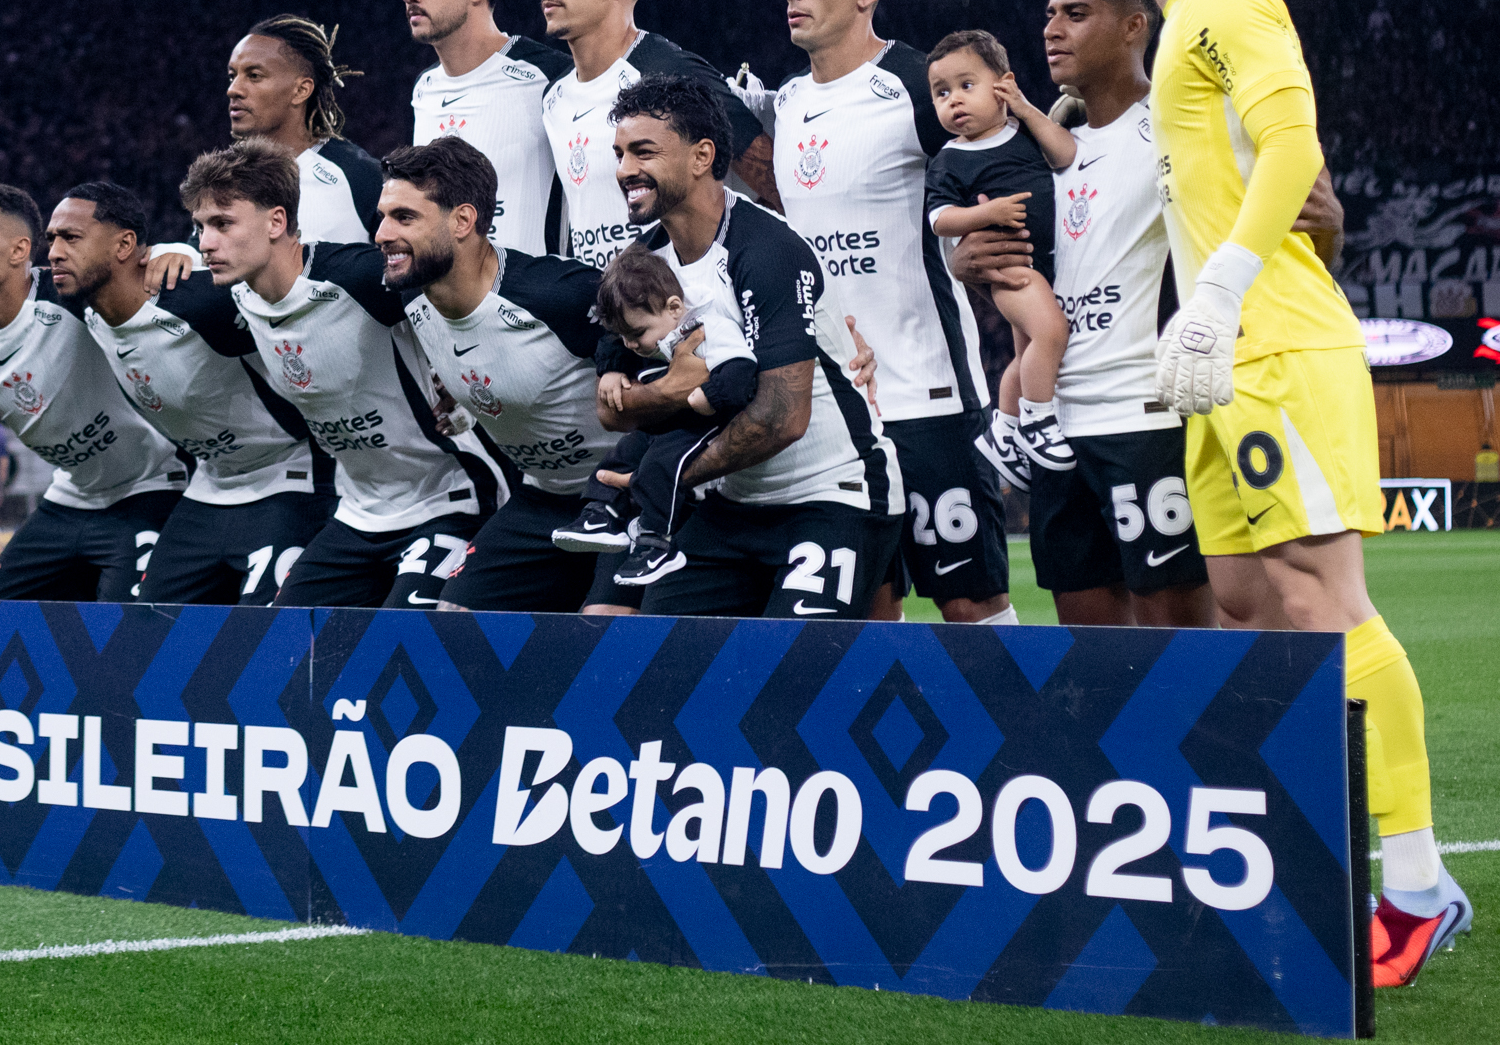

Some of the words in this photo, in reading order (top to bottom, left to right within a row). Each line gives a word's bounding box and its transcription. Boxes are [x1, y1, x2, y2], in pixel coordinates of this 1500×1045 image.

[820, 254, 878, 276] orte
[151, 315, 185, 336] Frimesa
[498, 304, 536, 330] Frimesa
[909, 488, 978, 545] 26
[1112, 476, 1192, 542] 56
[398, 534, 470, 579] 27
[782, 542, 856, 605] 21
[492, 725, 863, 875] Betano
[904, 769, 1274, 911] 2025
